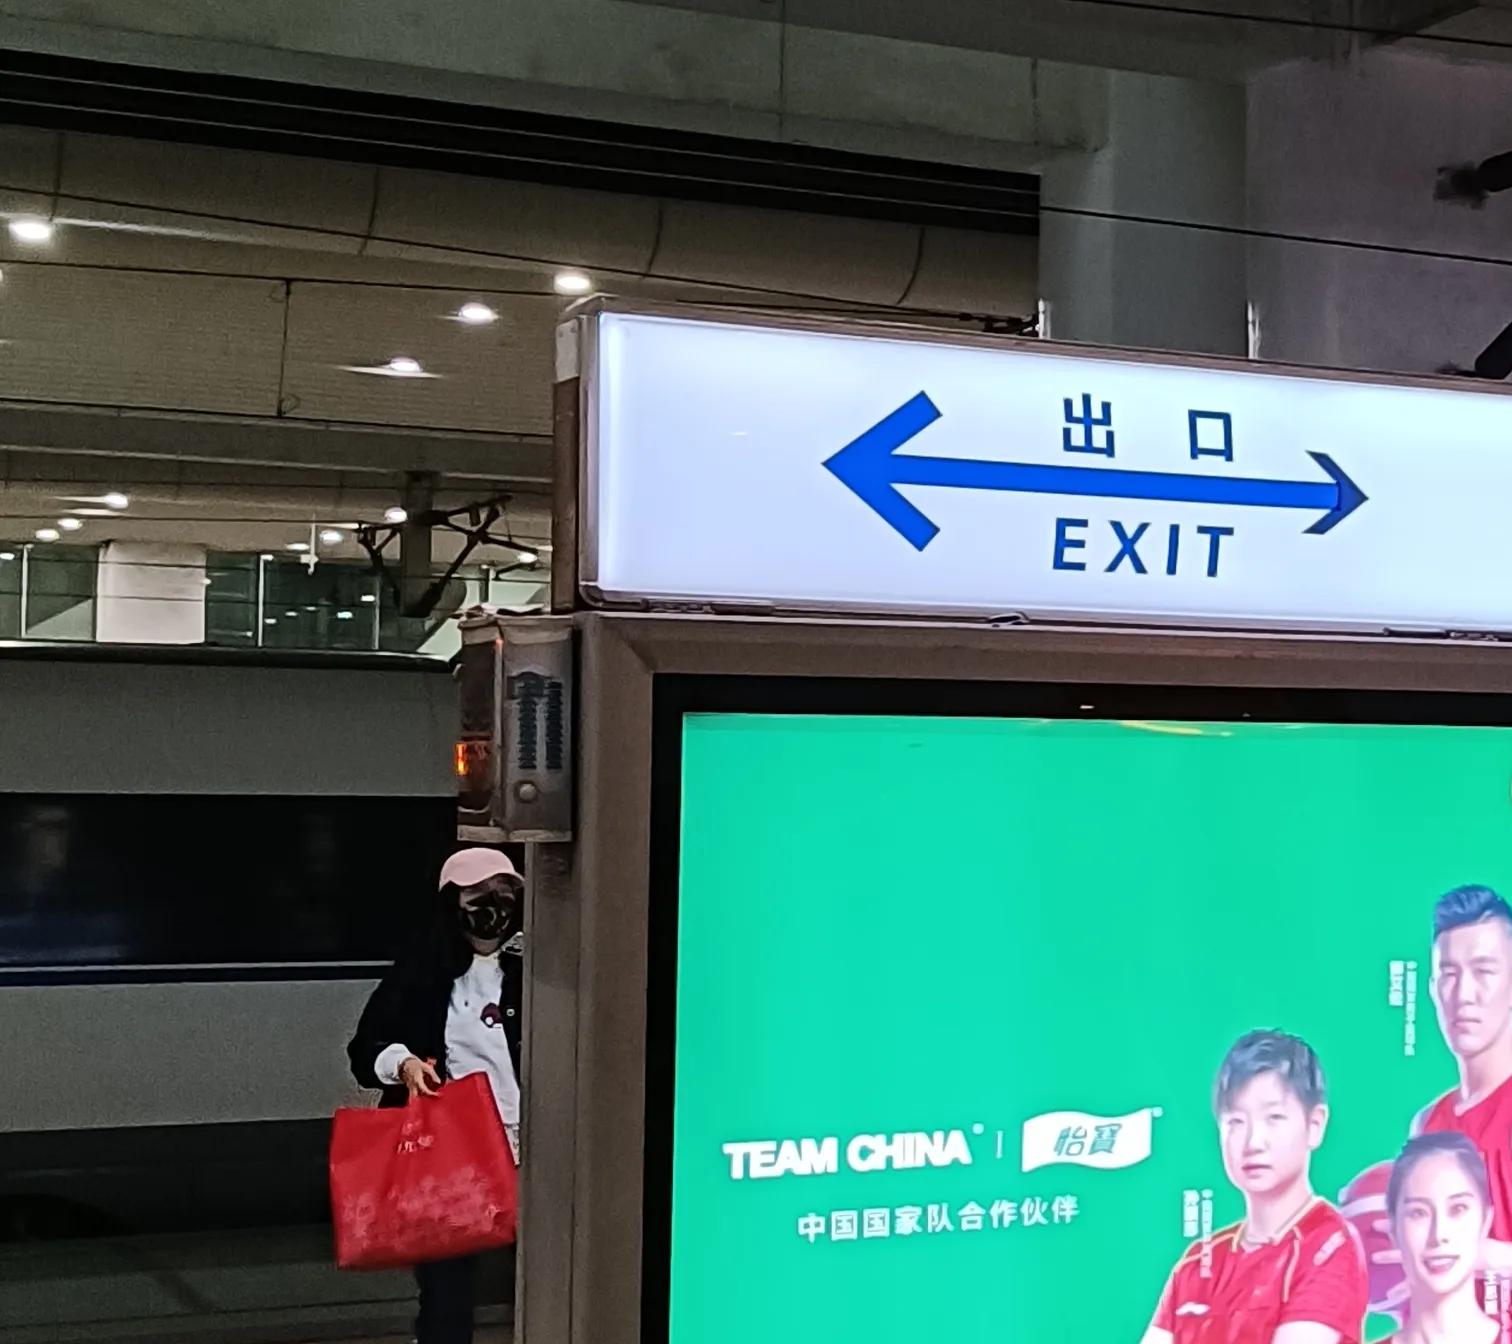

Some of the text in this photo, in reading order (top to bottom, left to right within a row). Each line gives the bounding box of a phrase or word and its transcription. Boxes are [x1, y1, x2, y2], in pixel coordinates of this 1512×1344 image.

[1062, 393, 1234, 462] 出口
[1052, 517, 1235, 579] EXIT
[722, 1129, 973, 1180] TEAM CHINA
[797, 1193, 1081, 1244] 中国国家队合作伙伴
